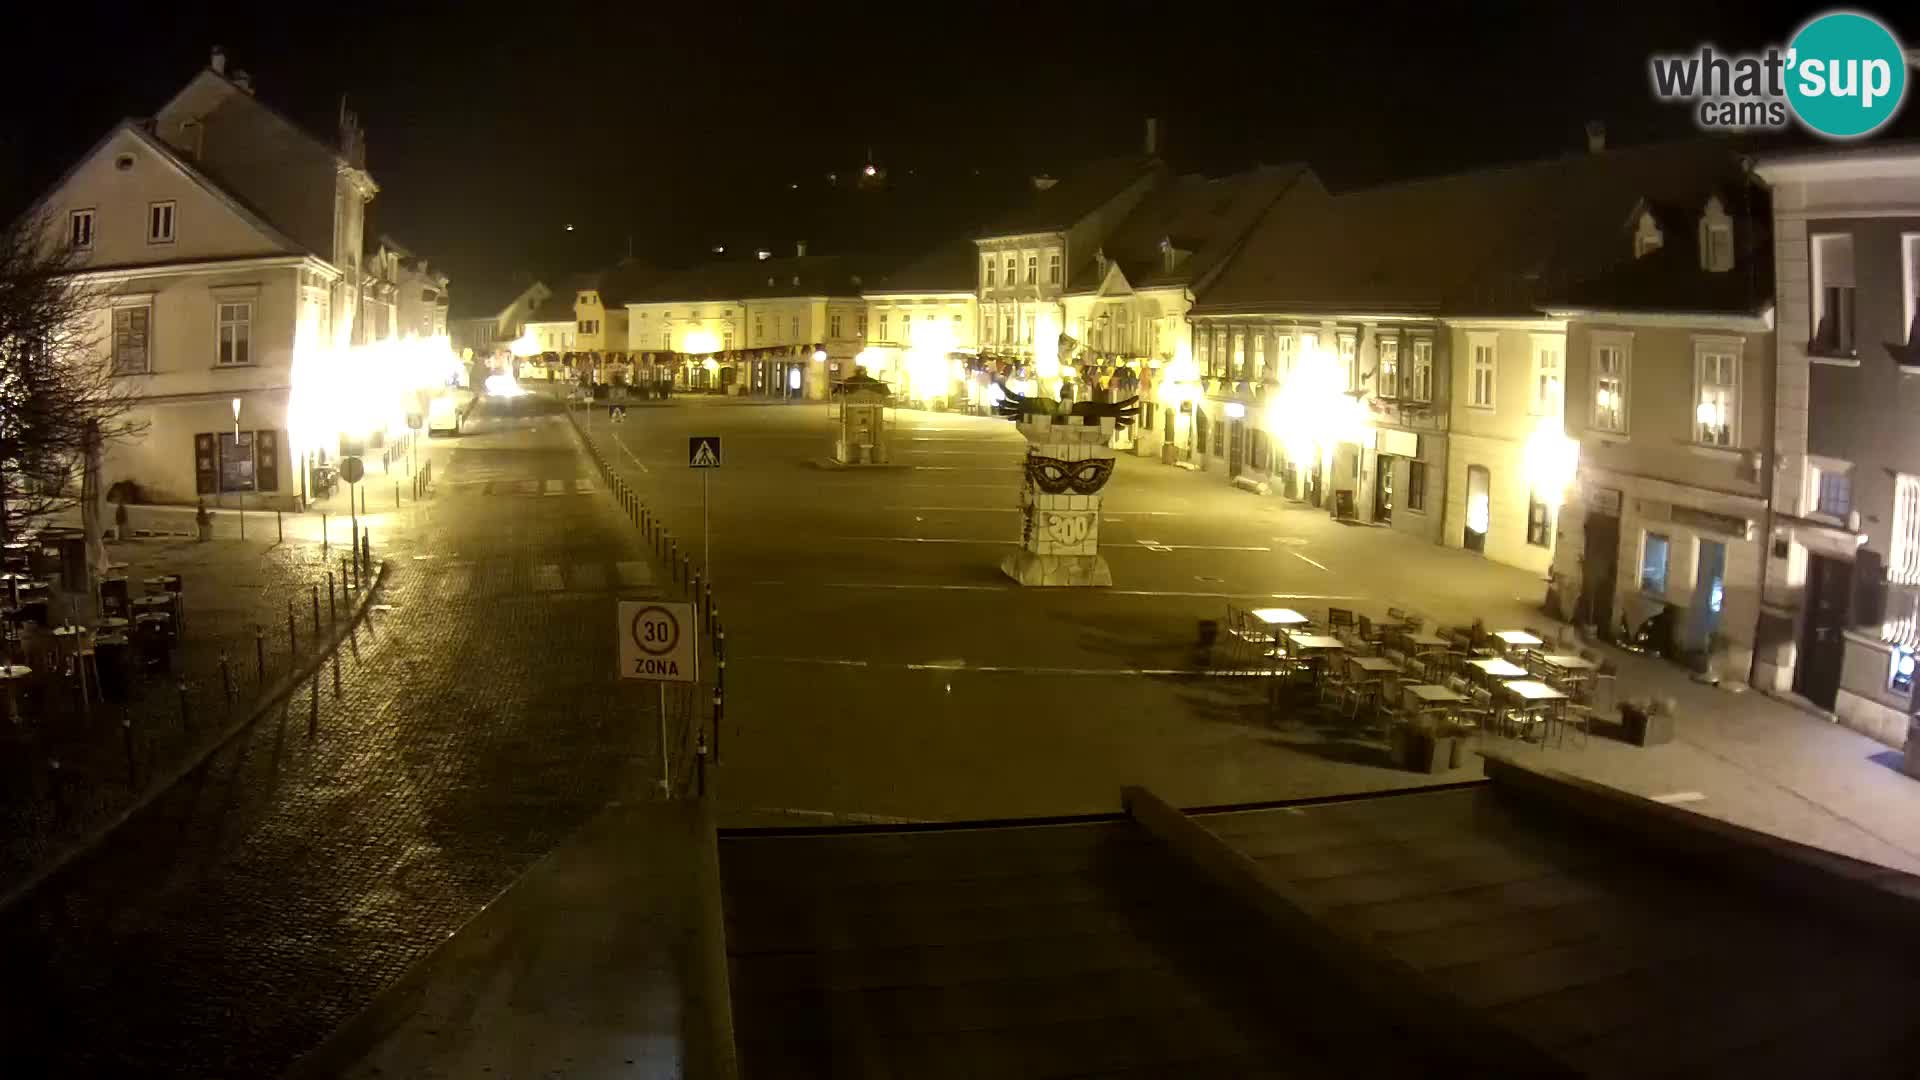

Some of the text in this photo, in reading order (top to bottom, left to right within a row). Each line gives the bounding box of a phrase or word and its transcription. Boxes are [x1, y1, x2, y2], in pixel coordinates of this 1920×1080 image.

[1049, 515, 1088, 545] 200
[644, 621, 668, 642] 30
[634, 659, 679, 676] ZONA
